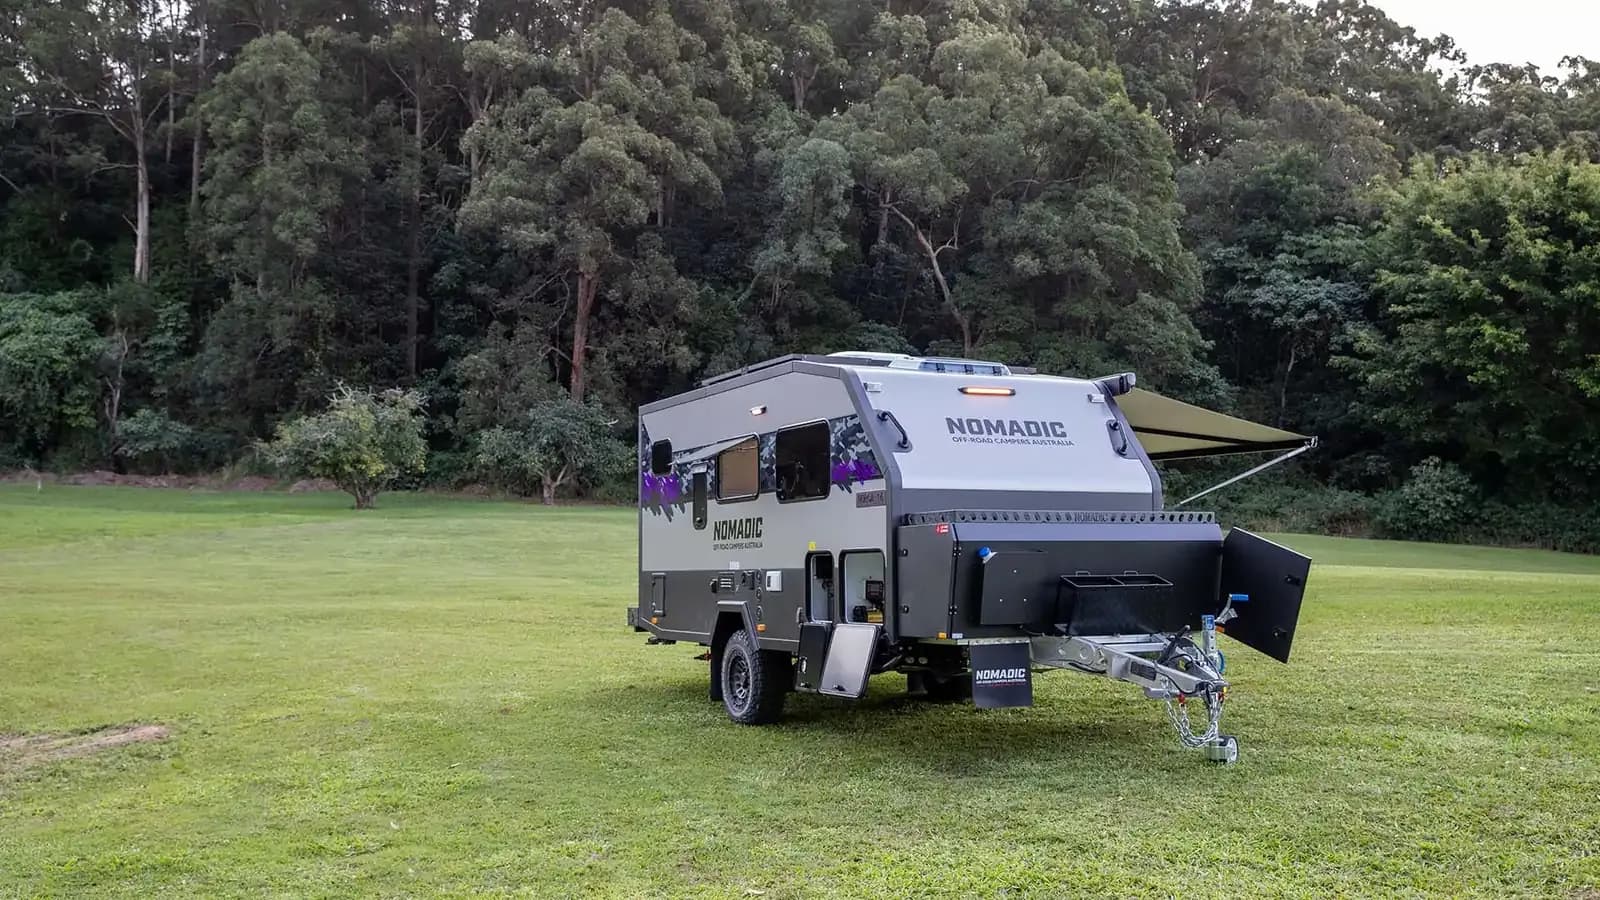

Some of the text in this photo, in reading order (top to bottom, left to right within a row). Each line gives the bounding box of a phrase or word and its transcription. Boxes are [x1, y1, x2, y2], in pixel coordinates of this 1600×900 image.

[945, 417, 1067, 438] NOMADIC
[952, 436, 1075, 447] OFF-ROAD CAMPERS AUSTRALIA
[713, 517, 763, 541] NOMADIC
[975, 668, 1026, 680] NOMADIC
